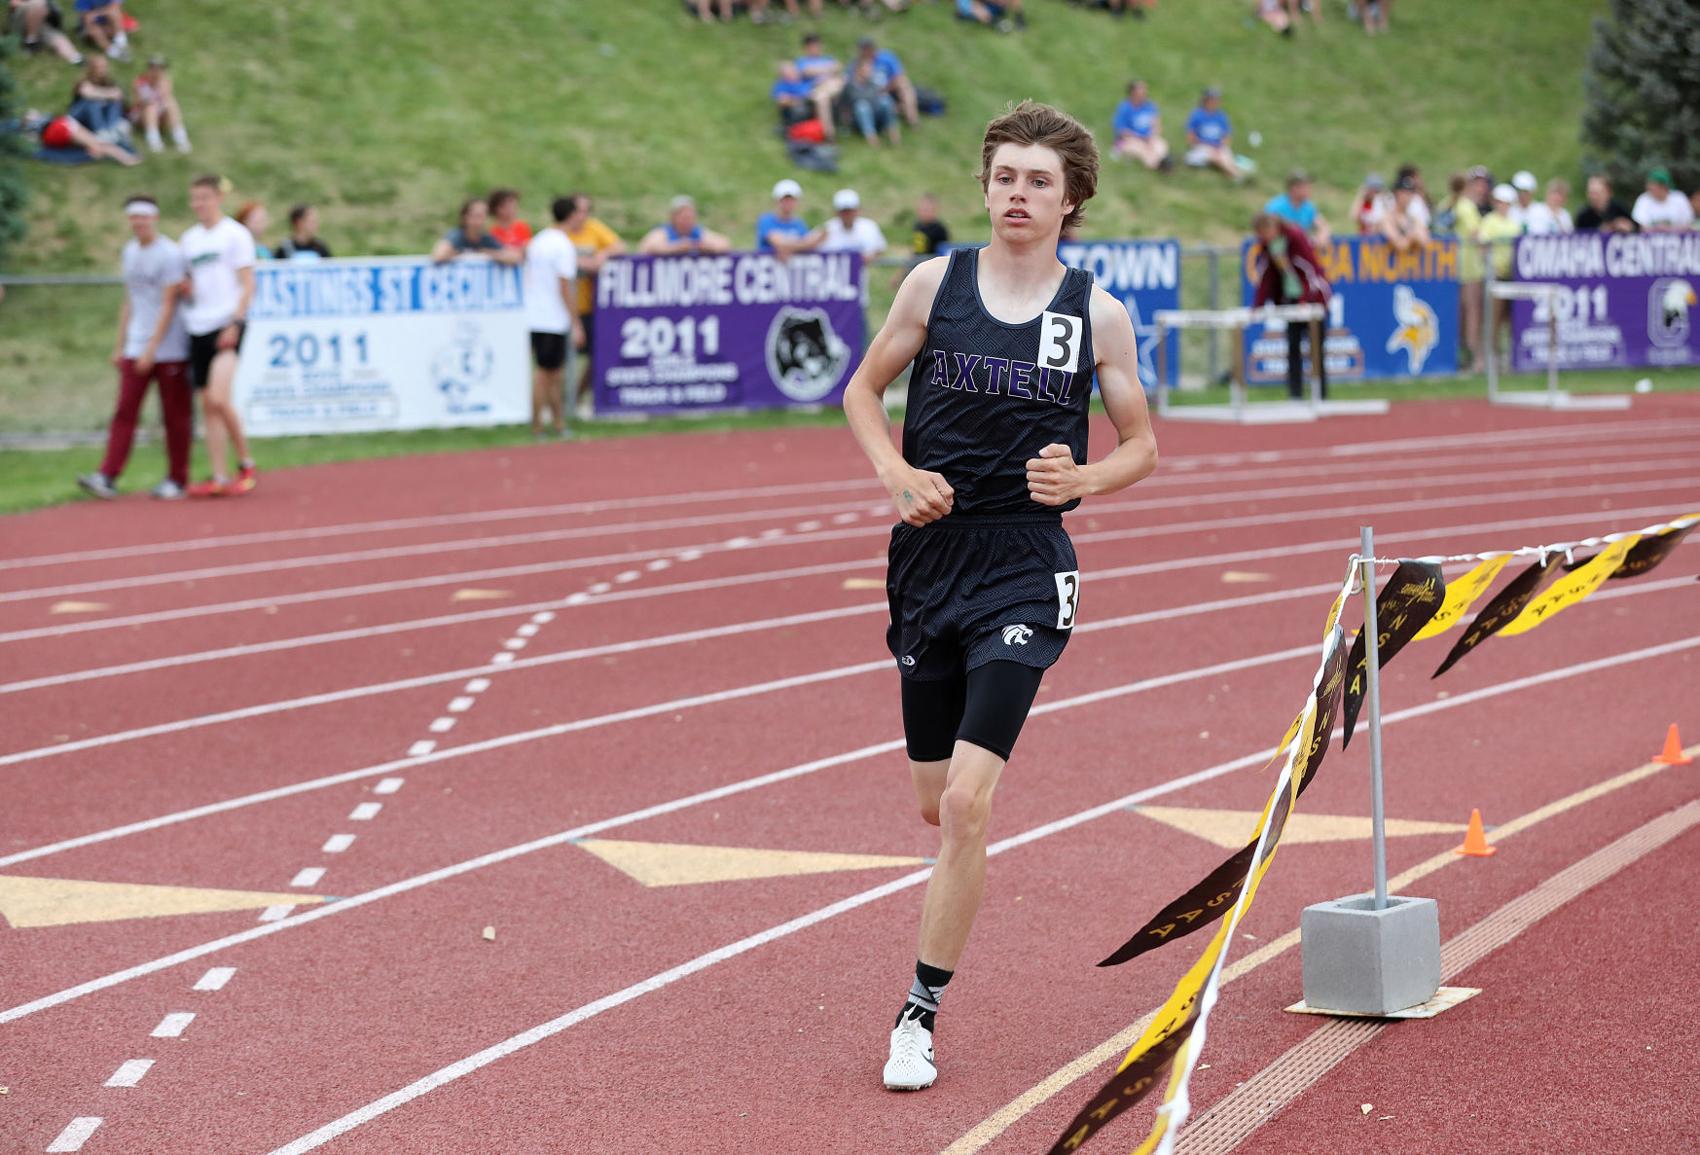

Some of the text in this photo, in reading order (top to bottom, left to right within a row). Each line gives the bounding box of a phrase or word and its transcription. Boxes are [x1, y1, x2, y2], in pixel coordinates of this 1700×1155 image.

[1061, 244, 1177, 290] TOWN
[1359, 239, 1458, 283] NORTH
[1517, 233, 1606, 279] OMAHA
[252, 268, 373, 317] ASTINGS
[379, 266, 413, 313] ST
[599, 254, 858, 307] FILLMORE CENTRAL
[268, 330, 368, 368] 2011
[620, 315, 720, 358] 2011
[1046, 316, 1074, 368] 3
[1062, 574, 1077, 627] 3
